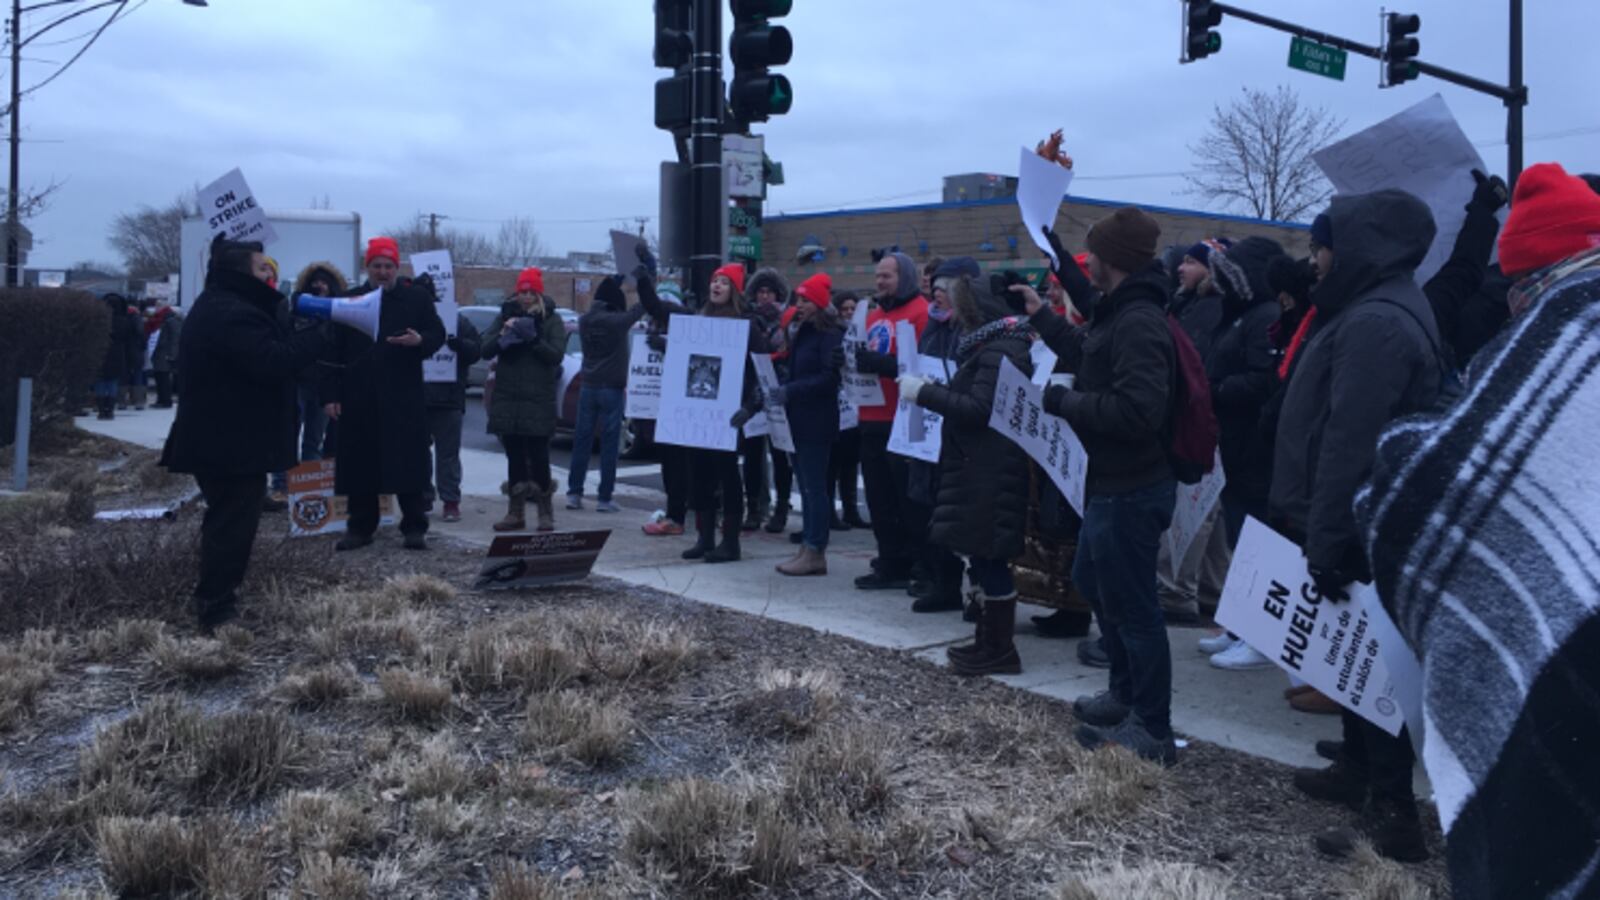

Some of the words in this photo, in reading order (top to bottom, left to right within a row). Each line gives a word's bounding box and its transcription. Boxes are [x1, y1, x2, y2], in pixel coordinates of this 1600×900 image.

[209, 196, 256, 230] STRIKE
[215, 190, 236, 208] ON
[631, 366, 663, 376] HUEL
[647, 353, 664, 363] EN
[1263, 579, 1291, 621] EN
[1280, 581, 1323, 671] HUELG
[1338, 609, 1351, 627] de
[1336, 620, 1368, 692] estudiantes
[1351, 692, 1362, 706] el
[1365, 638, 1379, 657] de
